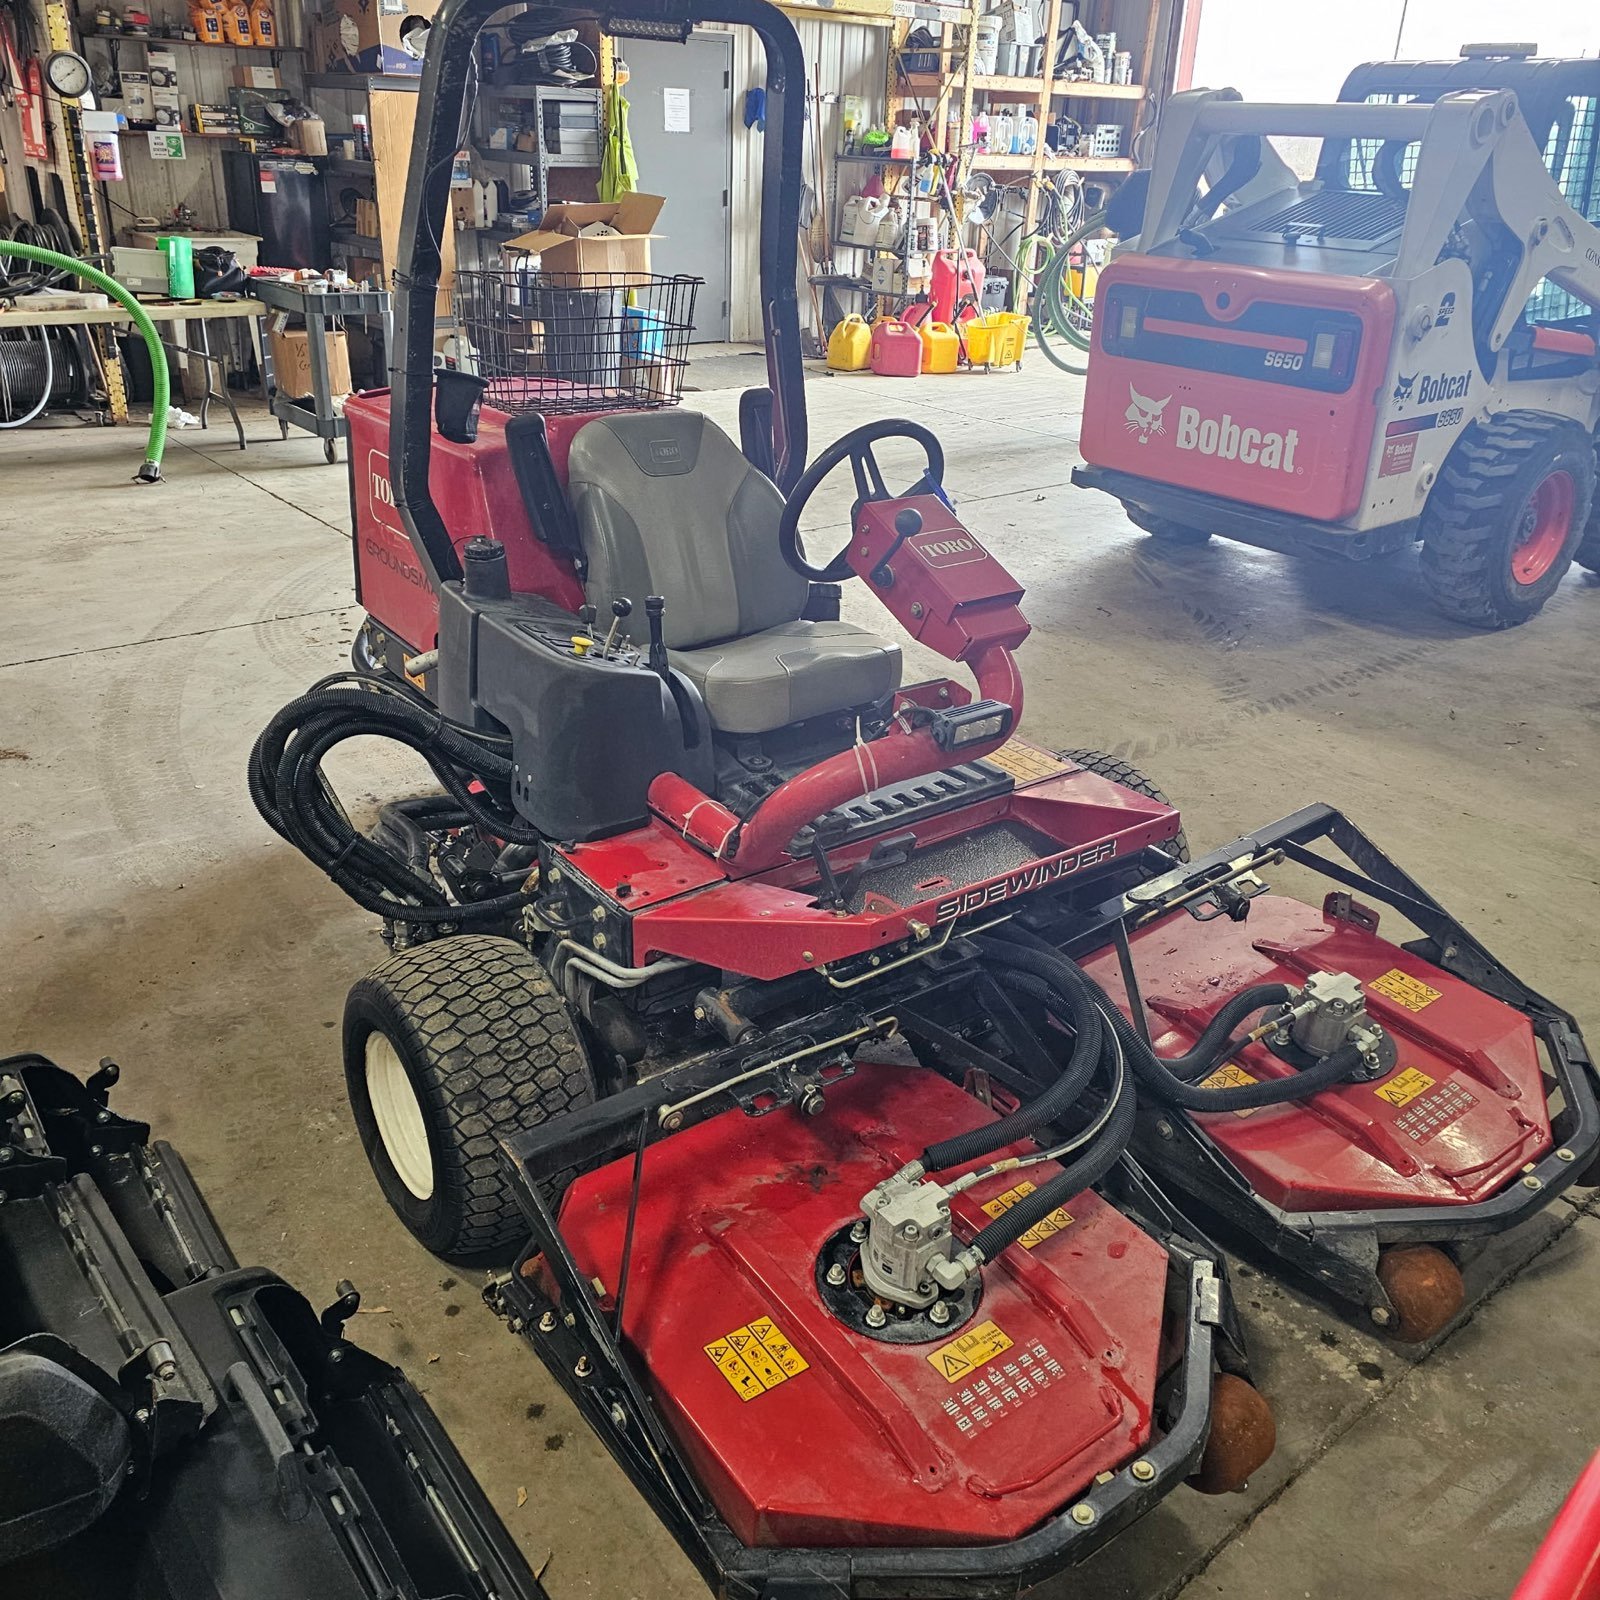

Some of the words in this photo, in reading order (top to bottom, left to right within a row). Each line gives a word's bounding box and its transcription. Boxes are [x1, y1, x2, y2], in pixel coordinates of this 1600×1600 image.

[243, 122, 254, 131] 90
[1437, 305, 1455, 316] SPEED
[1264, 351, 1304, 371] S650
[1417, 369, 1472, 405] Bobcat
[1437, 407, 1464, 428] S650
[1176, 405, 1299, 474] Bobcat
[921, 538, 973, 557] TORO
[366, 537, 438, 600] GROUNDSM
[937, 839, 1117, 924] SIDEWINDER
